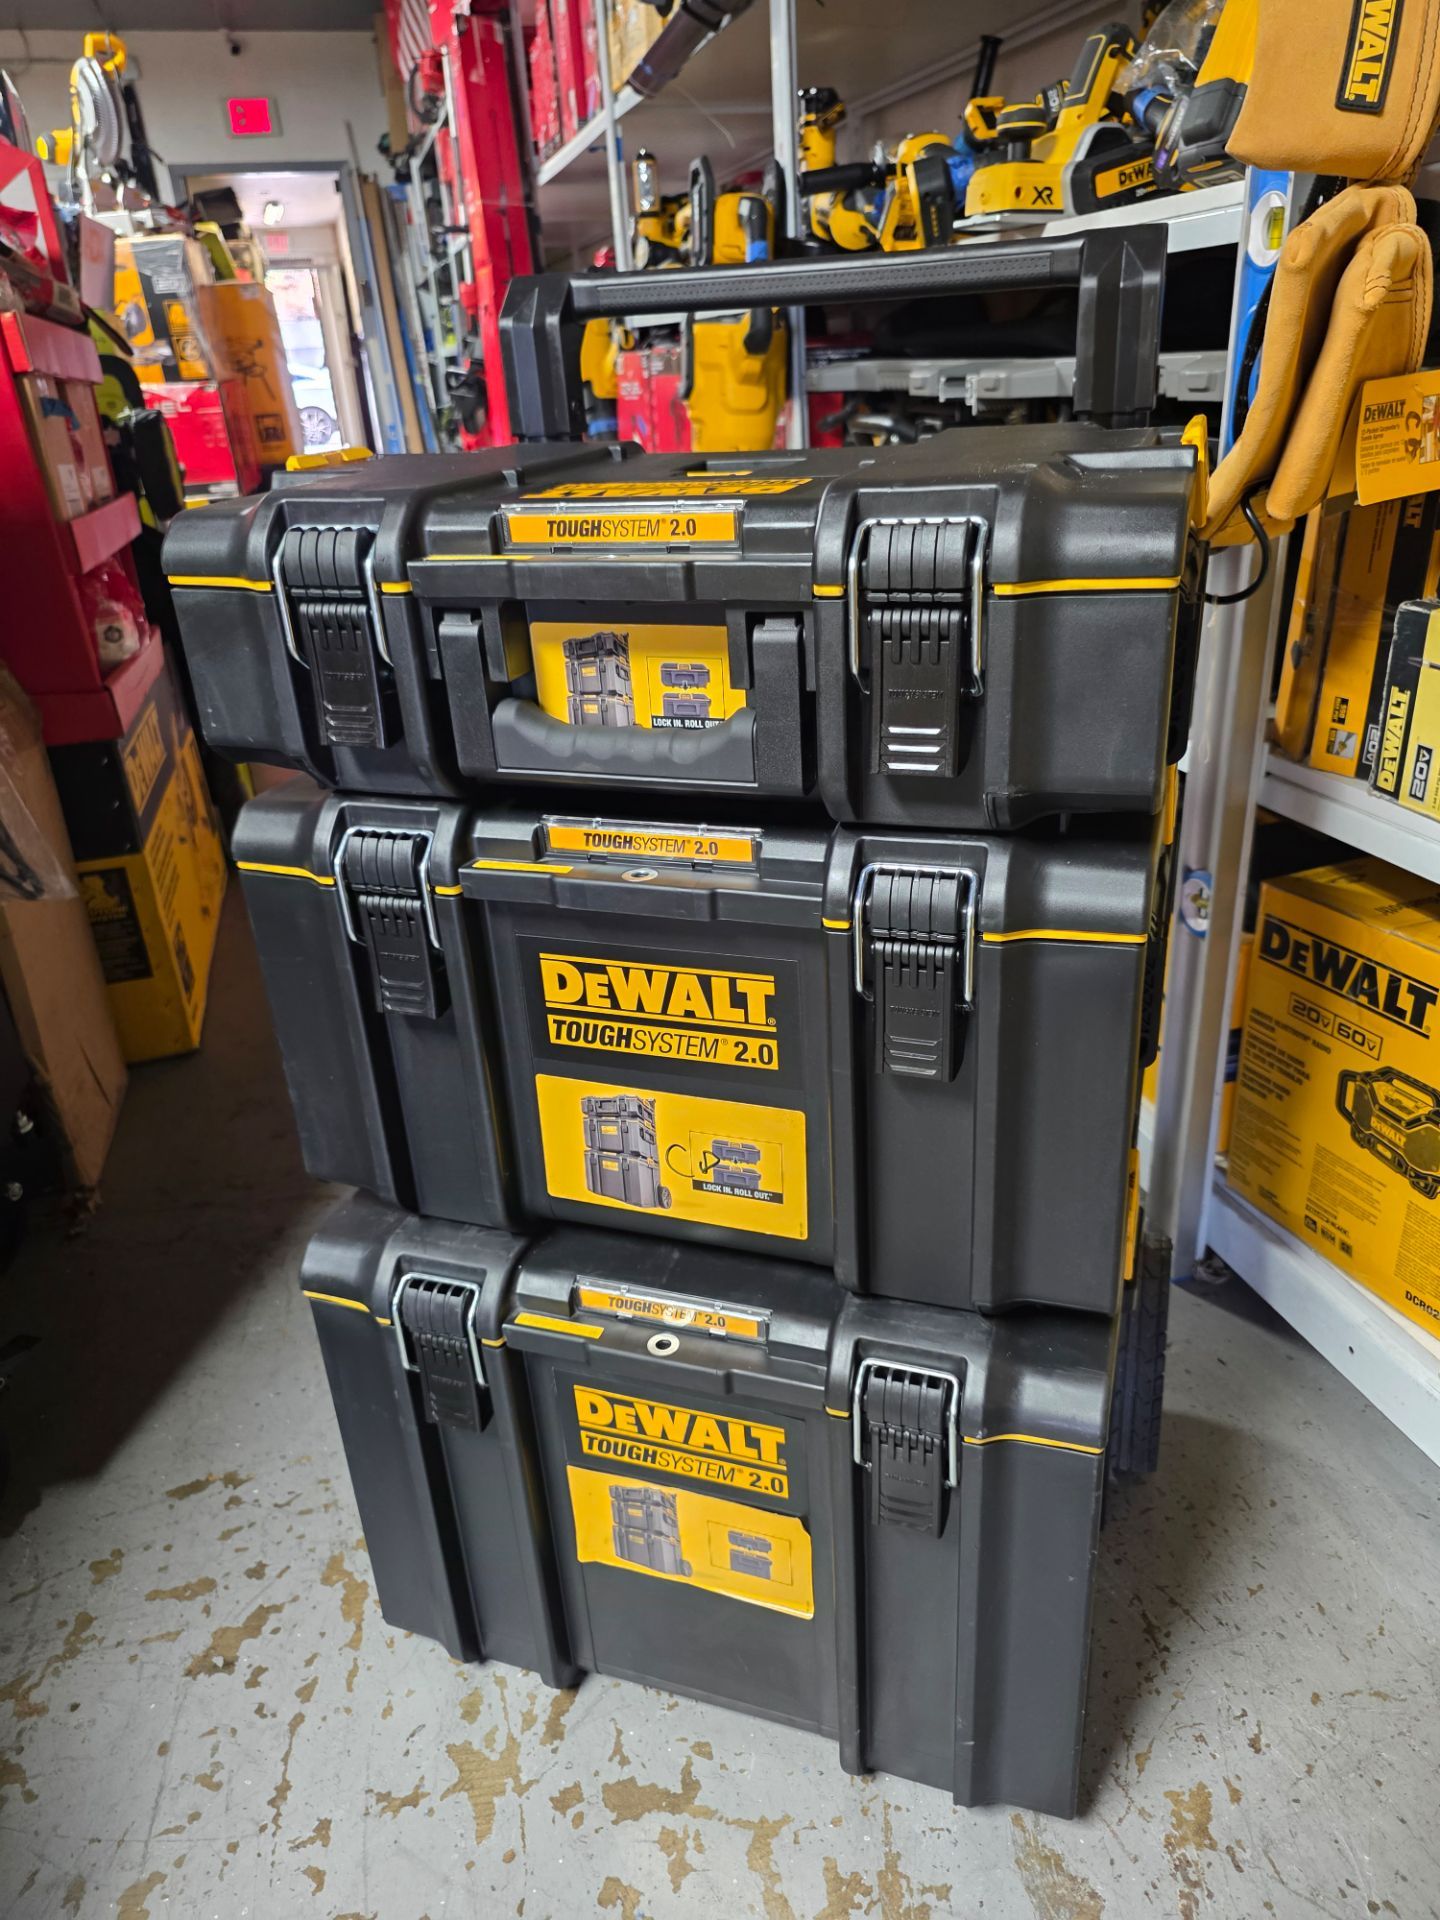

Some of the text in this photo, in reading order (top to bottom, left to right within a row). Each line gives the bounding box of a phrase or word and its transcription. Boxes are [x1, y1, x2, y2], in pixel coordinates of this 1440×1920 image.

[1031, 186, 1054, 205] XR
[1364, 399, 1407, 424] DEWALT
[669, 518, 697, 537] 2.0
[652, 717, 673, 728] LOCK
[684, 720, 704, 729] ROLL
[1376, 685, 1411, 792] DEWALT
[1411, 748, 1430, 799] 20V
[694, 840, 719, 856] 2.0
[1259, 917, 1440, 1031] DEWALT
[733, 1040, 774, 1065] 2.0
[702, 1182, 722, 1193] LOCK
[733, 1187, 753, 1198] ROLL
[704, 1313, 726, 1328] 2.0
[574, 1386, 786, 1465] DEWALT
[749, 1471, 785, 1494] 2.0
